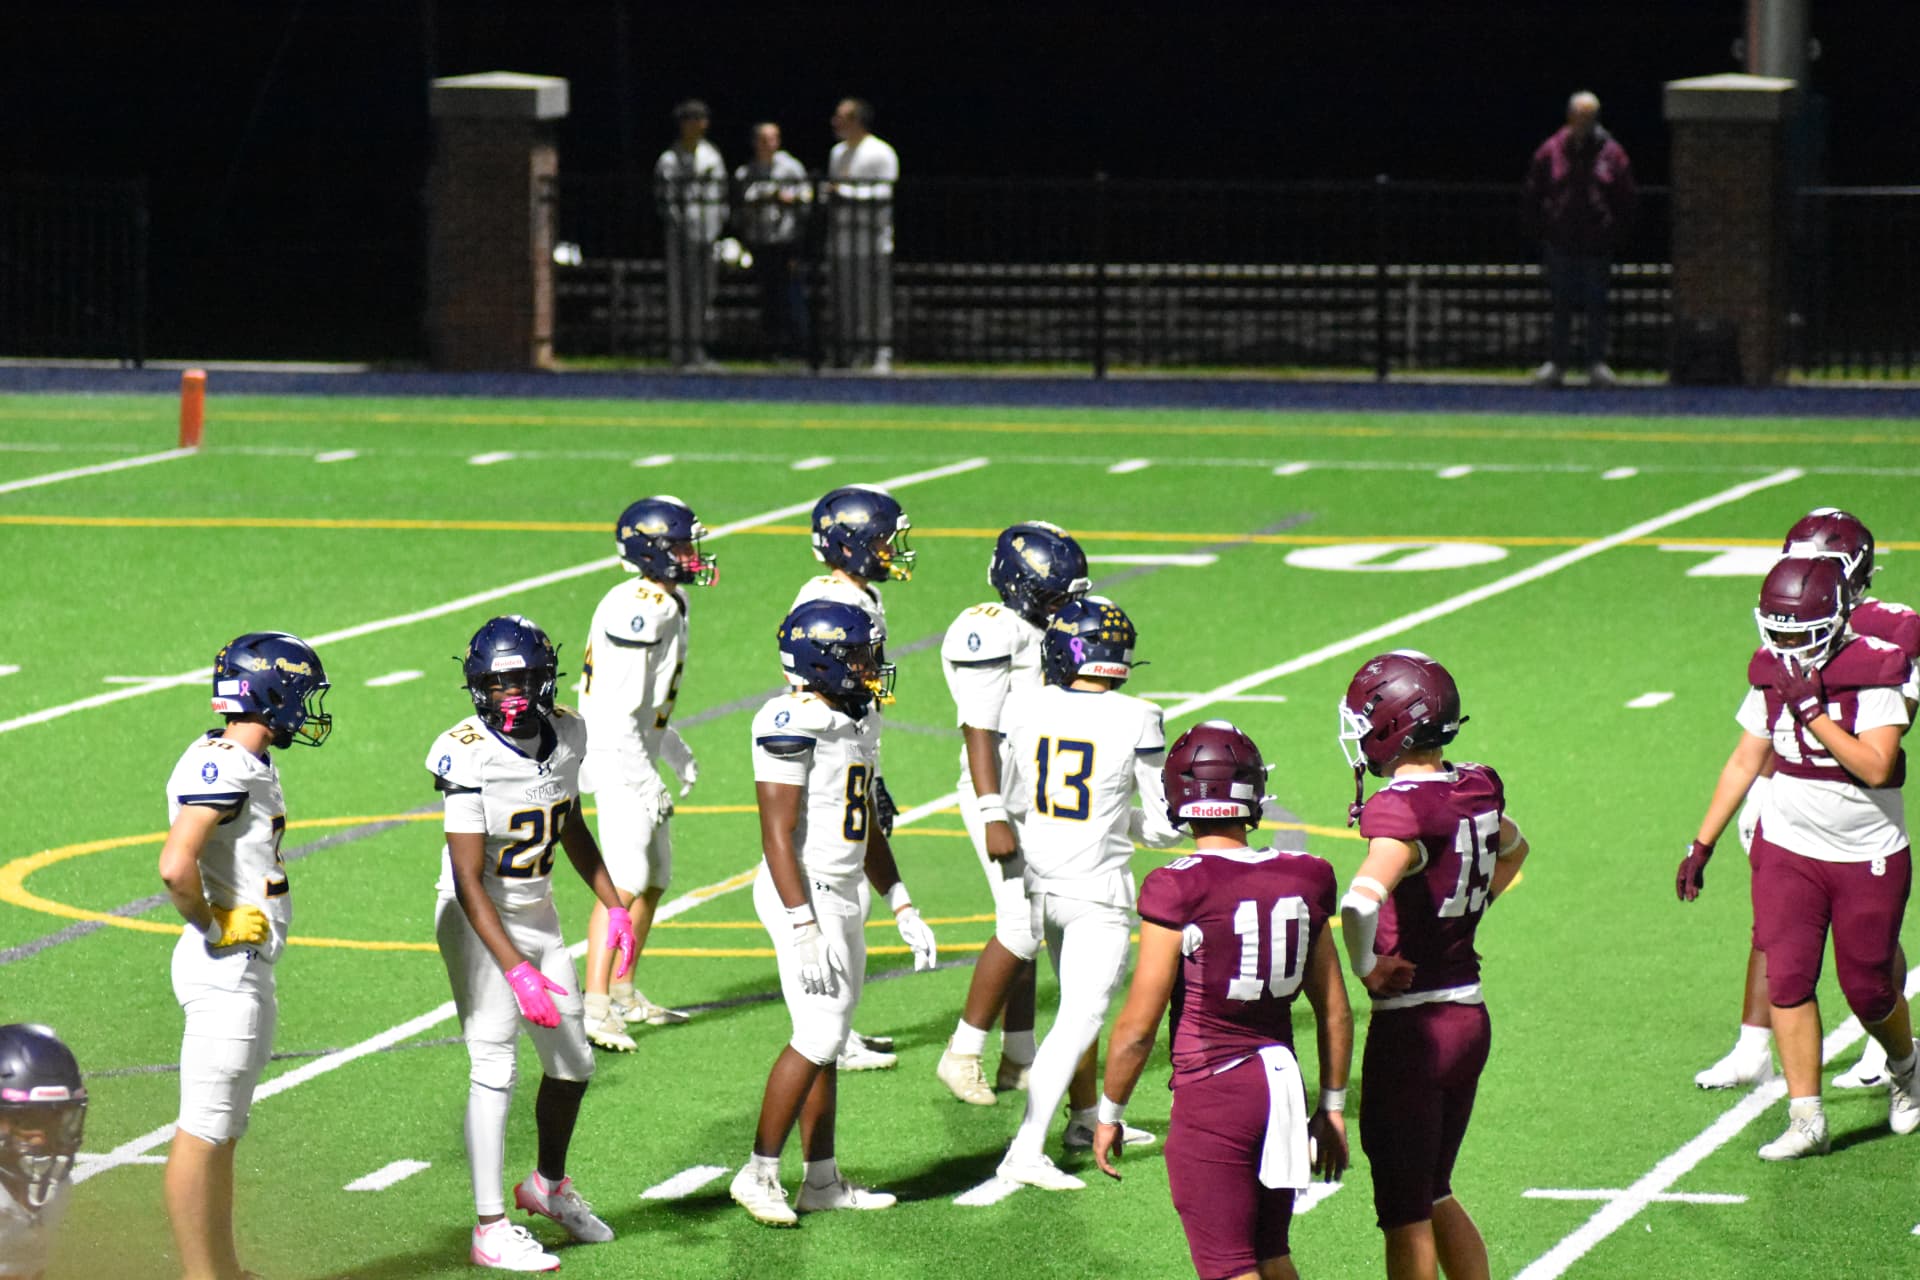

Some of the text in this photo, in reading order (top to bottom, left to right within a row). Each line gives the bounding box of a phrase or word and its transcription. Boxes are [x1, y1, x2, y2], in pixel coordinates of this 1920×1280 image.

[843, 763, 874, 843] 8
[1034, 735, 1096, 823] 13
[1191, 805, 1240, 817] Riddell
[1437, 809, 1500, 918] 15
[1226, 896, 1311, 1001] 10
